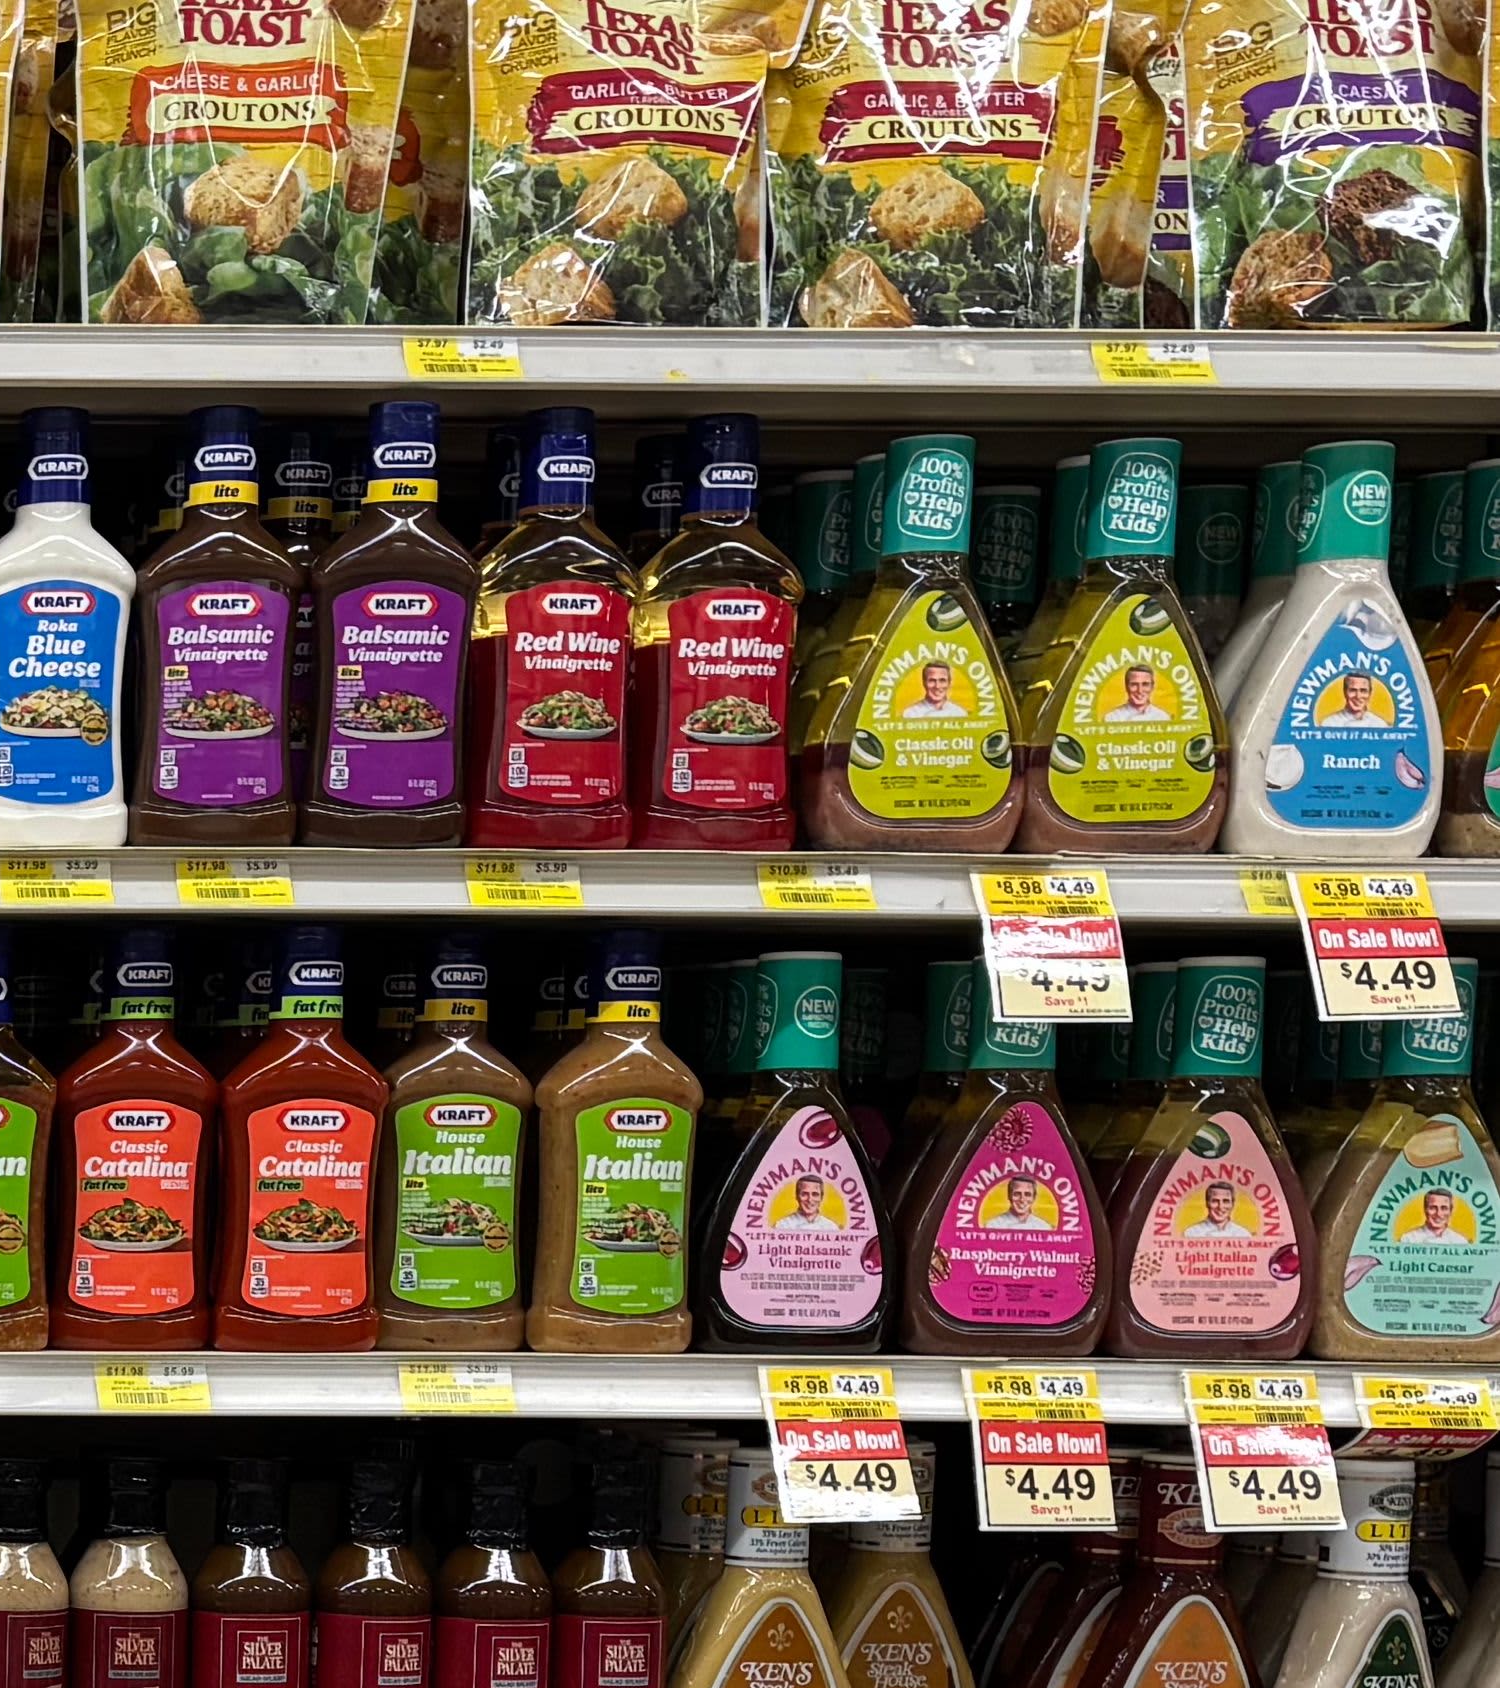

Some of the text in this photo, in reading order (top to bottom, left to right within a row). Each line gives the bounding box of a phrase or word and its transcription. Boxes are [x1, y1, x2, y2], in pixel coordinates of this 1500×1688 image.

[163, 73, 321, 94] CHEESE & GARLIC
[163, 100, 317, 125] CROUTONS
[919, 457, 965, 478] 100%
[213, 483, 240, 499] lite
[908, 473, 966, 497] Profits
[919, 493, 963, 515] Help
[906, 508, 953, 531] Kids
[678, 638, 784, 659] Red Wine
[687, 661, 777, 678] Vinaigrette
[1290, 655, 1415, 729] NEWMAN'S OWN
[1323, 754, 1381, 771] Ranch
[476, 862, 515, 874] $11.98
[535, 862, 568, 873] $5.99
[1314, 880, 1361, 897] $8.98
[1368, 881, 1414, 897] $4.49
[1318, 927, 1440, 949] On Sale Now!
[1341, 960, 1437, 993] $4.49
[121, 1000, 172, 1015] fat free
[802, 997, 837, 1013] NEW
[83, 1156, 189, 1179] Catalina
[950, 1248, 1081, 1266] Raspberry Walnut
[1389, 1259, 1474, 1275] Light Caesar
[244, 1642, 282, 1656] SILVER
[242, 1655, 283, 1669] PALATE
[739, 1662, 813, 1684] KEN'S
